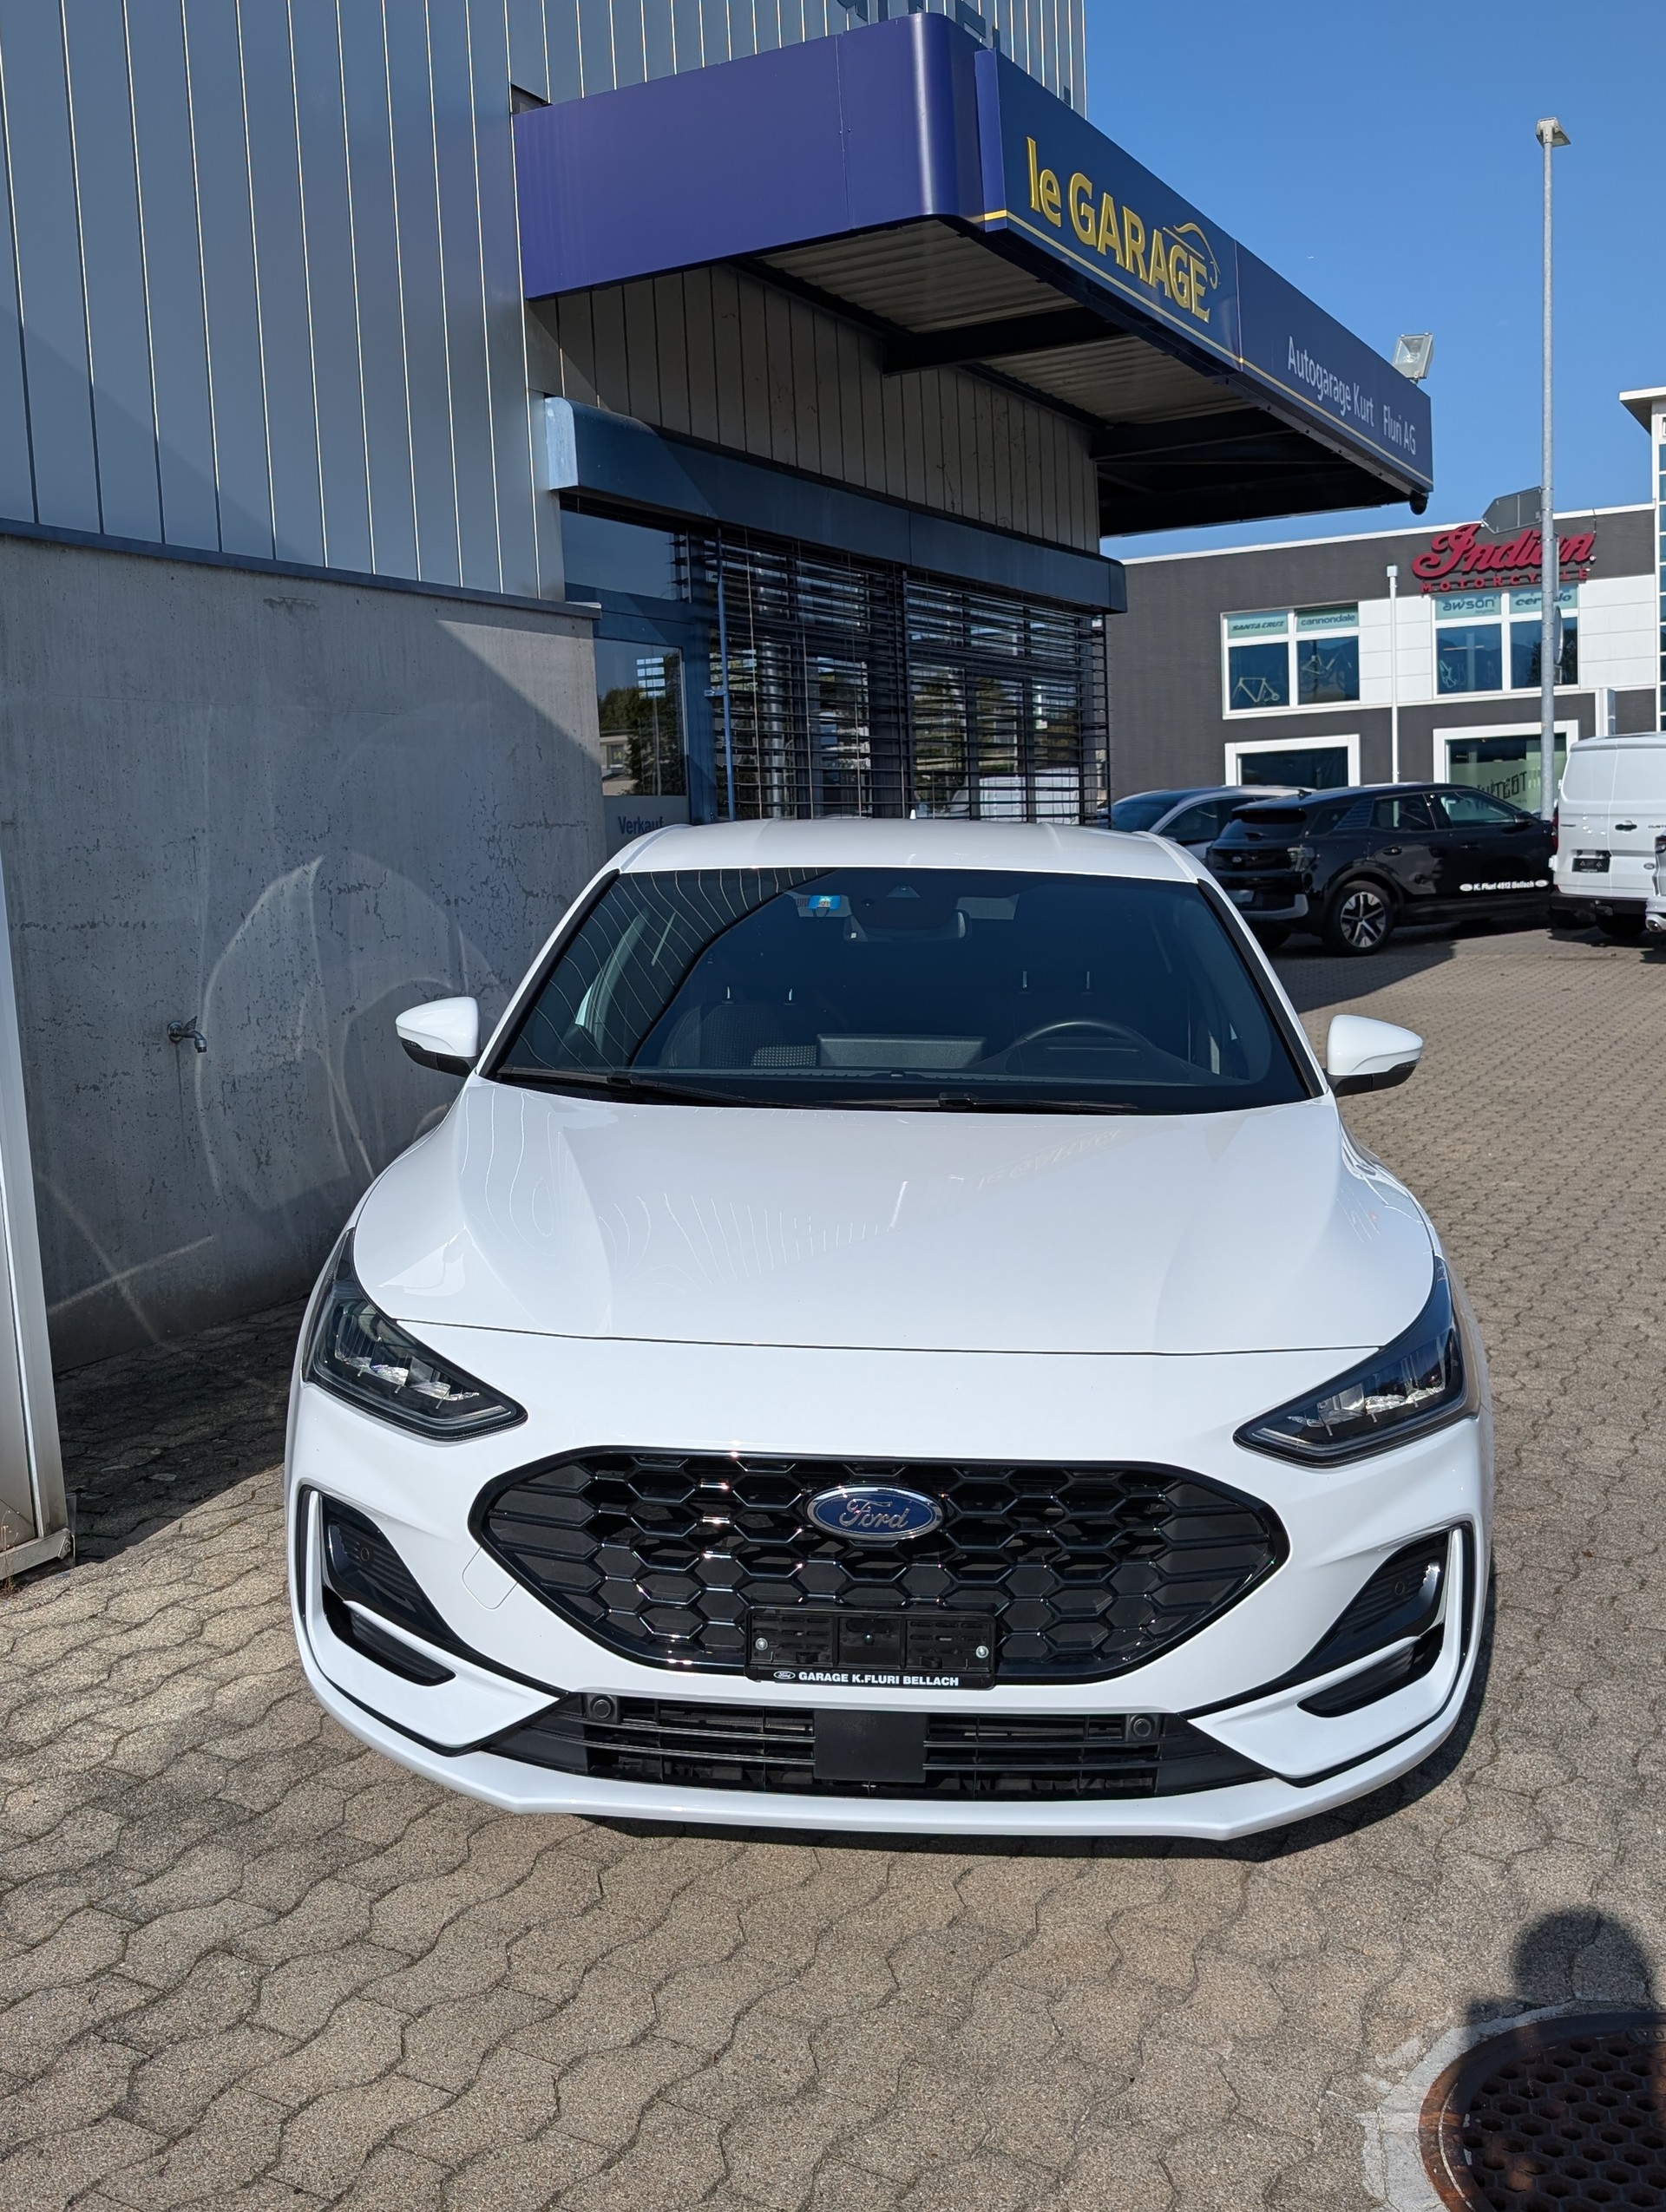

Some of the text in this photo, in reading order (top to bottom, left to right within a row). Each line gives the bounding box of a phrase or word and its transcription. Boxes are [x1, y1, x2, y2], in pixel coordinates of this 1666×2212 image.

[1026, 136, 1210, 324] le GARAGE
[1288, 335, 1416, 455] Autogarage Kurt Fluri AG
[1412, 523, 1596, 578] Indin
[1420, 569, 1588, 593] MOTORCYLE
[1232, 620, 1285, 632] SANTA CRUZ
[1301, 614, 1355, 626] cannondale
[838, 1498, 910, 1529] Ford
[798, 1671, 849, 1683] GARAGE
[852, 1673, 900, 1685] K.FLURI
[902, 1675, 959, 1686] BELLACH
